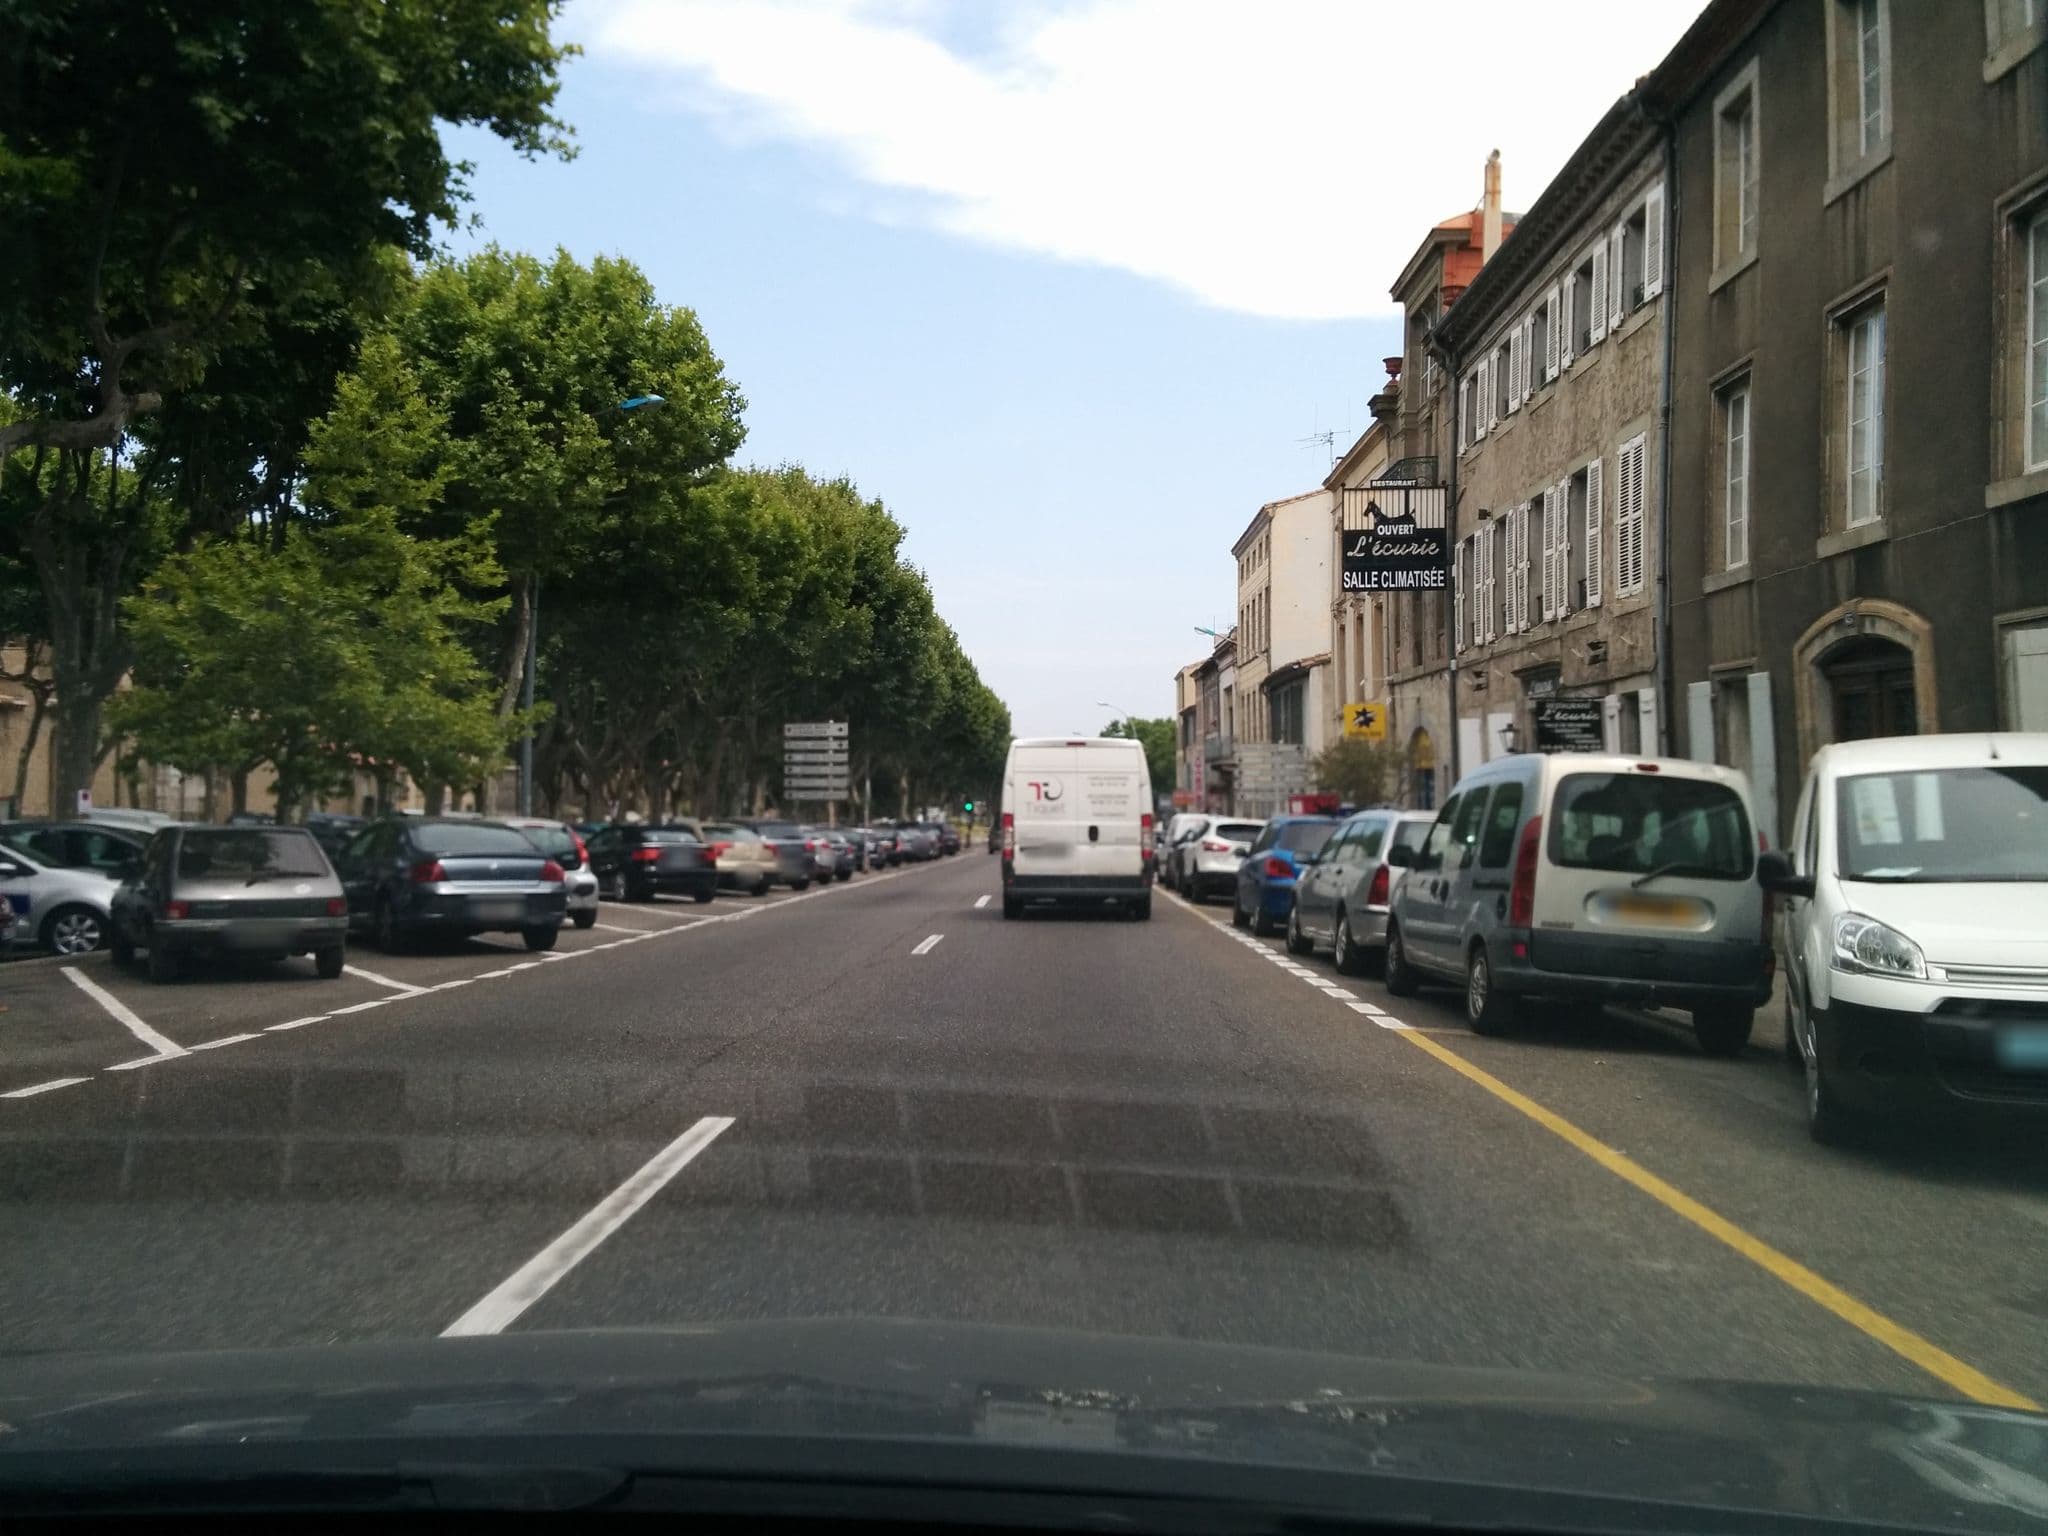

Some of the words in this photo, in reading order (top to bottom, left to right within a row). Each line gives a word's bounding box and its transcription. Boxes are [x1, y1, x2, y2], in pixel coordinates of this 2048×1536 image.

[1377, 524, 1414, 535] OUVERT
[1347, 536, 1440, 556] L'écurie
[1343, 571, 1378, 588] SALLE
[1381, 566, 1445, 587] CLIMATISÉE
